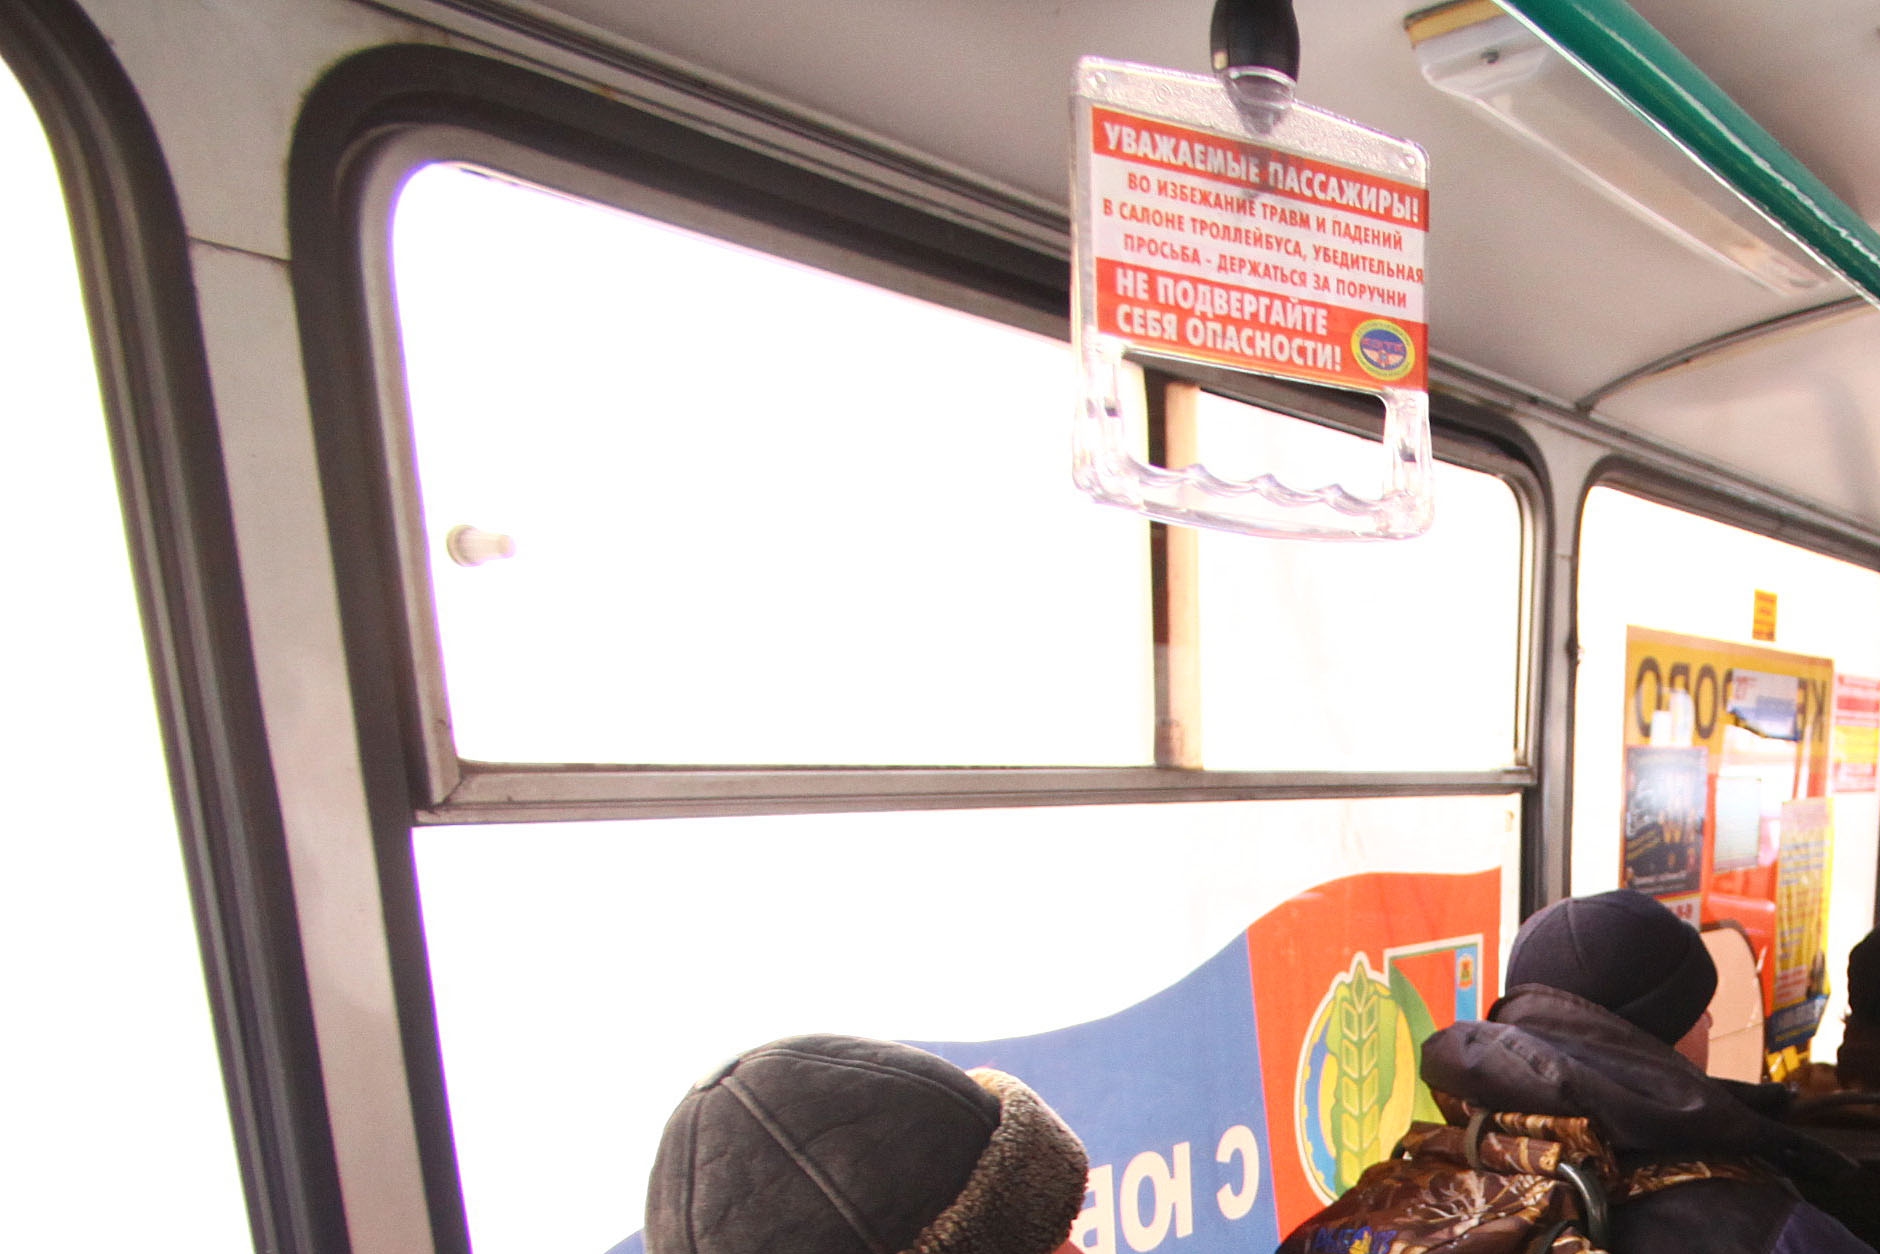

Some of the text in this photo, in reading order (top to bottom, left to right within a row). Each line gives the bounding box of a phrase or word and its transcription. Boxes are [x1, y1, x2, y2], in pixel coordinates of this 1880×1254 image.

[1102, 121, 1420, 223] УВАЖАЕМЫЕ ПАССАЖИРЫ!
[1127, 171, 1403, 251] ВО ИЗБЕЖАНИЕ ТРАВМ И ПАДЕНИЙ
[1102, 197, 1425, 284] В САЛОНЕ ТРОЛЛЕЙБУСА, УБЕДИТЕЛЬНАЯ
[1122, 233, 1201, 266] ПРОСЬБА
[1217, 253, 1308, 287] ДЕРЖАТЬСЯ
[1312, 273, 1331, 292] ЗА
[1336, 276, 1408, 309] ПОРУЧНИ
[1115, 267, 1328, 336] НЕ ПОДВЕРГАЙТЕ
[1115, 304, 1179, 342] СЕБЯ
[1186, 318, 1342, 371] ОПАСНОСТИ!
